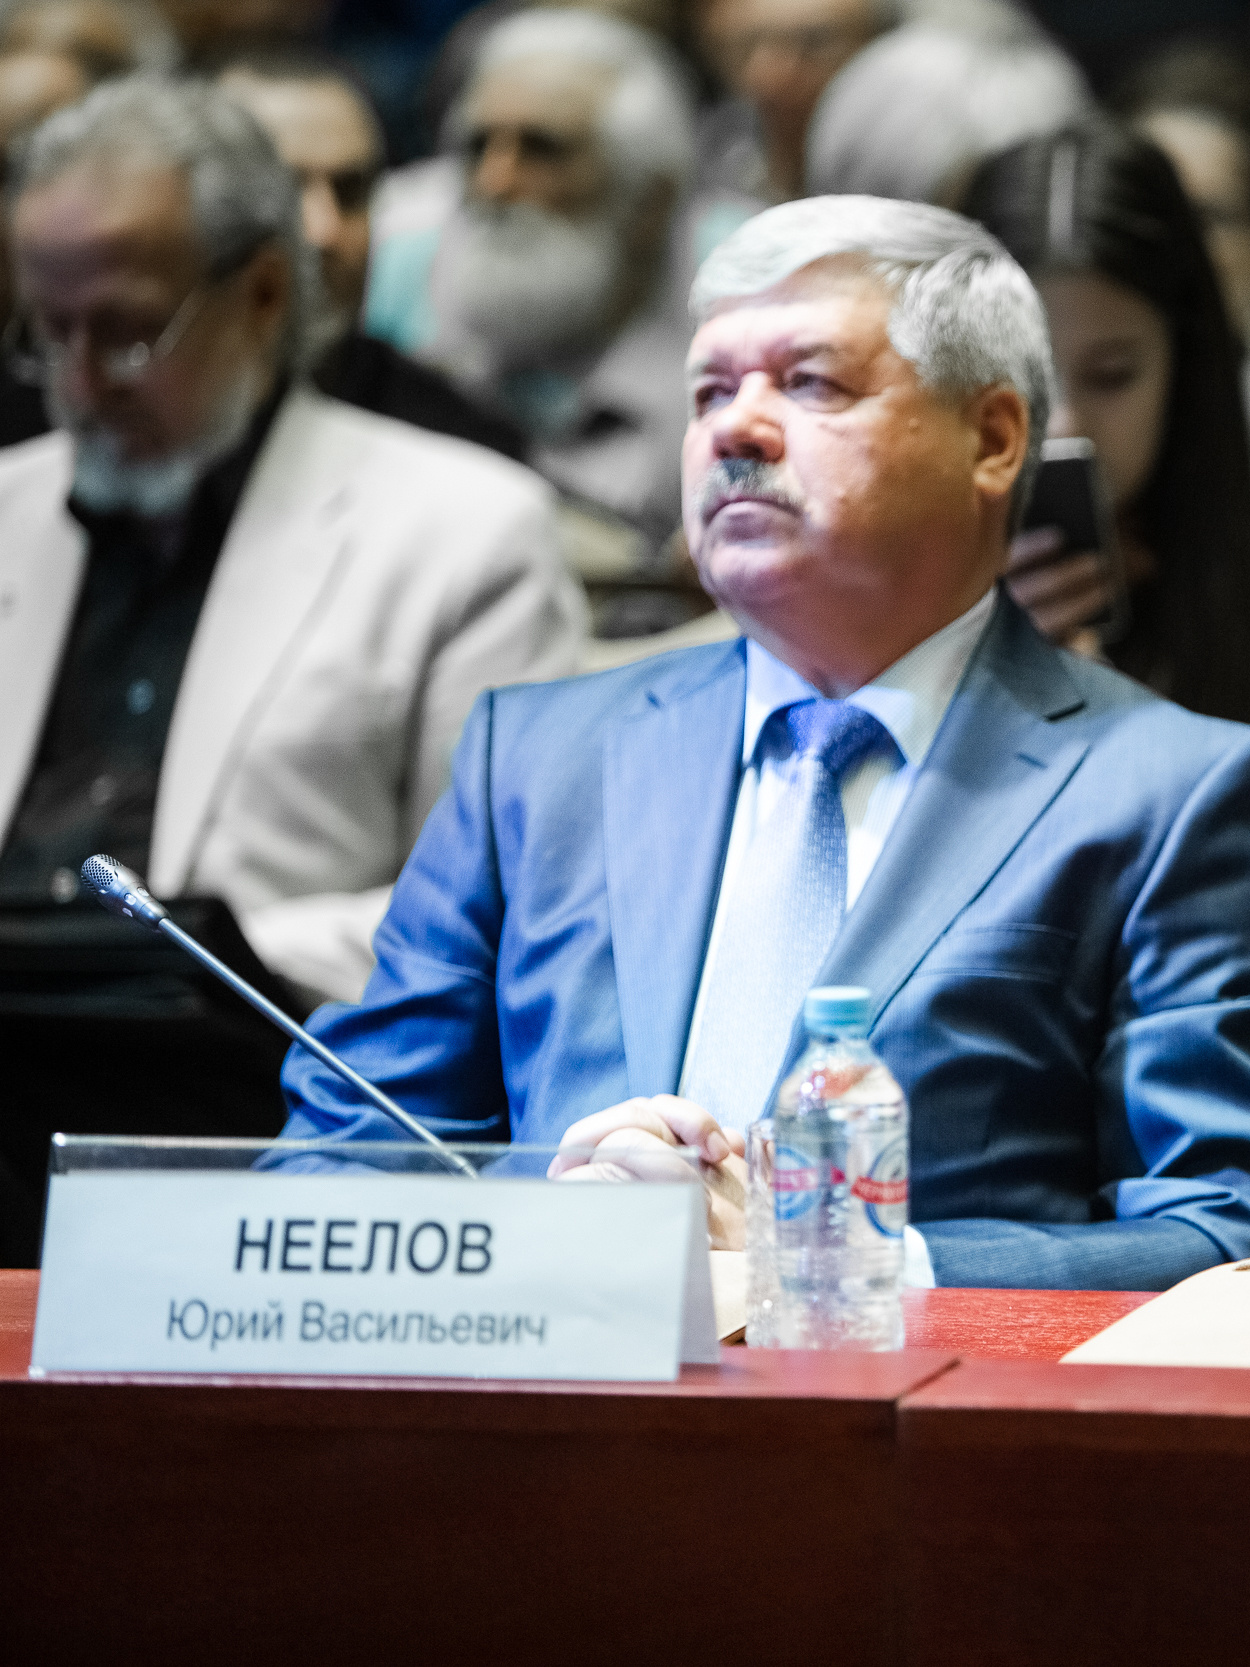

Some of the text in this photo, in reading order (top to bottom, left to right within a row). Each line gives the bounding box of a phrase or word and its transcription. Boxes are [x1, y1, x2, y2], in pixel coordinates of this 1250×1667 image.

[235, 1218, 493, 1274] НЕЕЛОВ
[167, 1298, 548, 1349] Юрий Васильевич
